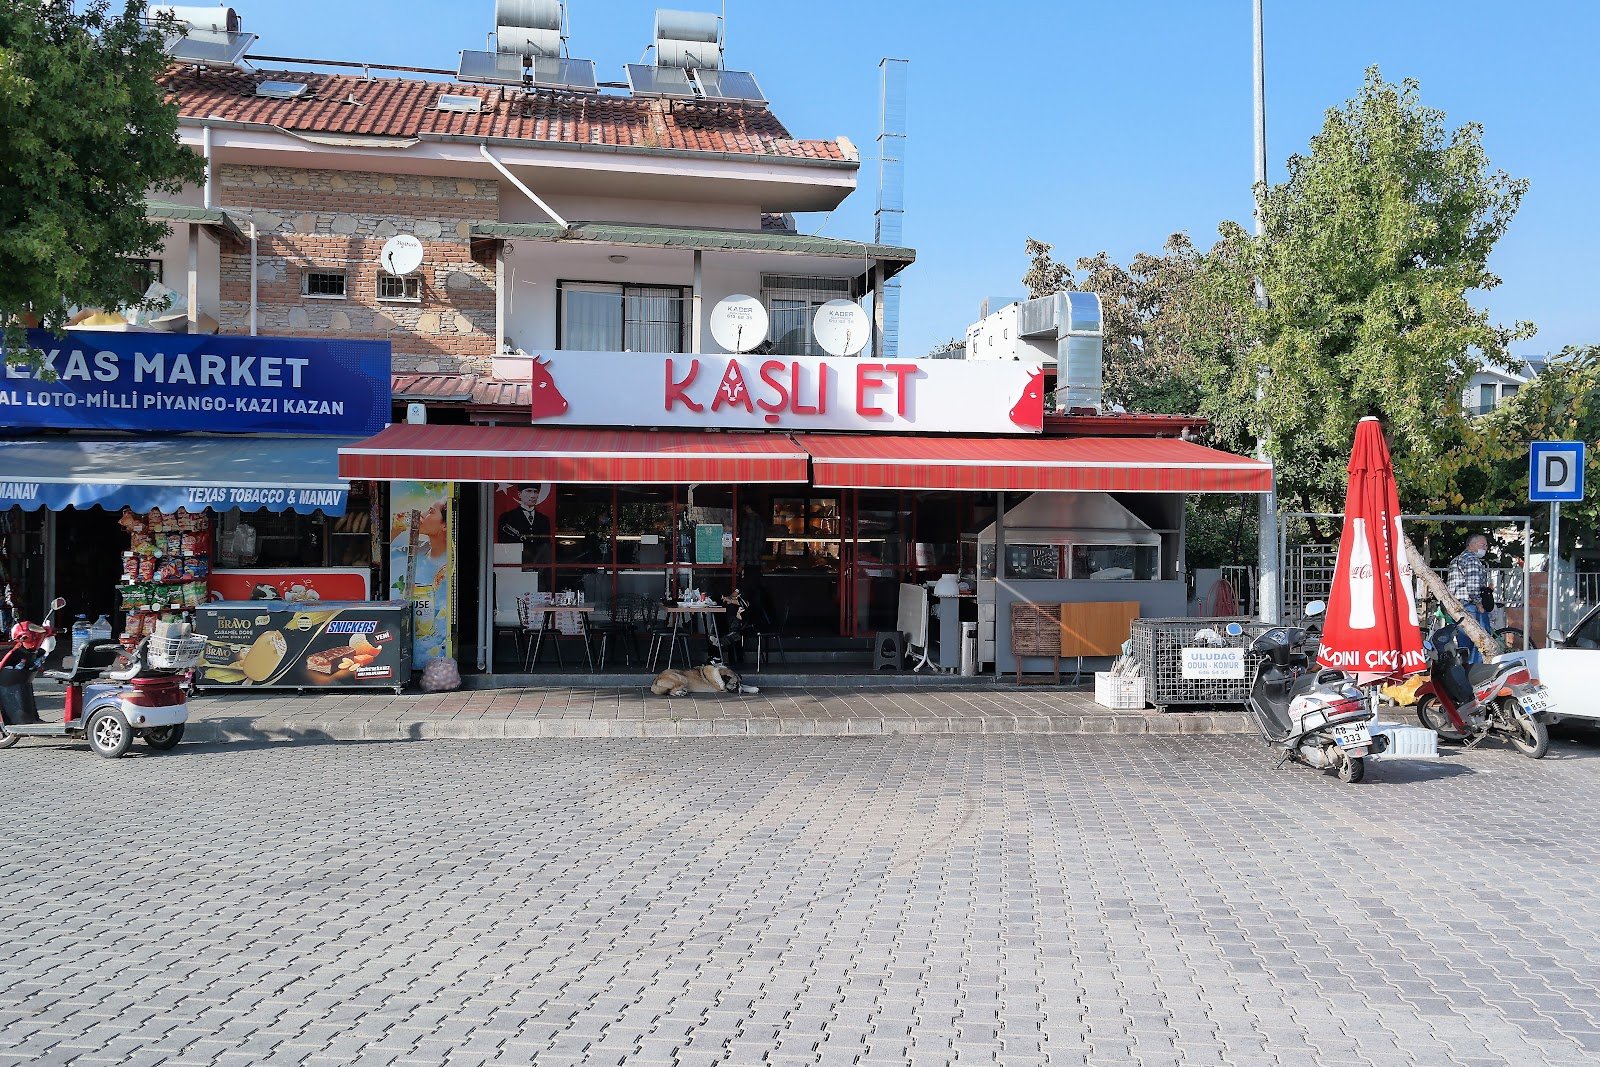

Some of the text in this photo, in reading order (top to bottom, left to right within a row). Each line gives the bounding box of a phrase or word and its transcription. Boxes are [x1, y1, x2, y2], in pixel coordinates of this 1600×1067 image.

[727, 305, 753, 313] KADER
[134, 352, 309, 388] MARKET
[664, 358, 918, 424] KAŞLI ET
[26, 389, 138, 409] LOTO-MİLLİ
[143, 391, 278, 413] PİYANGO-KAZI
[283, 399, 344, 416] KAZAN
[1545, 455, 1568, 487] D
[188, 487, 342, 506] TEXAS TOBACCO & MANAV
[218, 617, 252, 630] BRAVO
[328, 621, 377, 633] SNICKERS
[1187, 661, 1208, 669] ODUN
[1335, 726, 1347, 735] 48
[1343, 733, 1362, 743] 333
